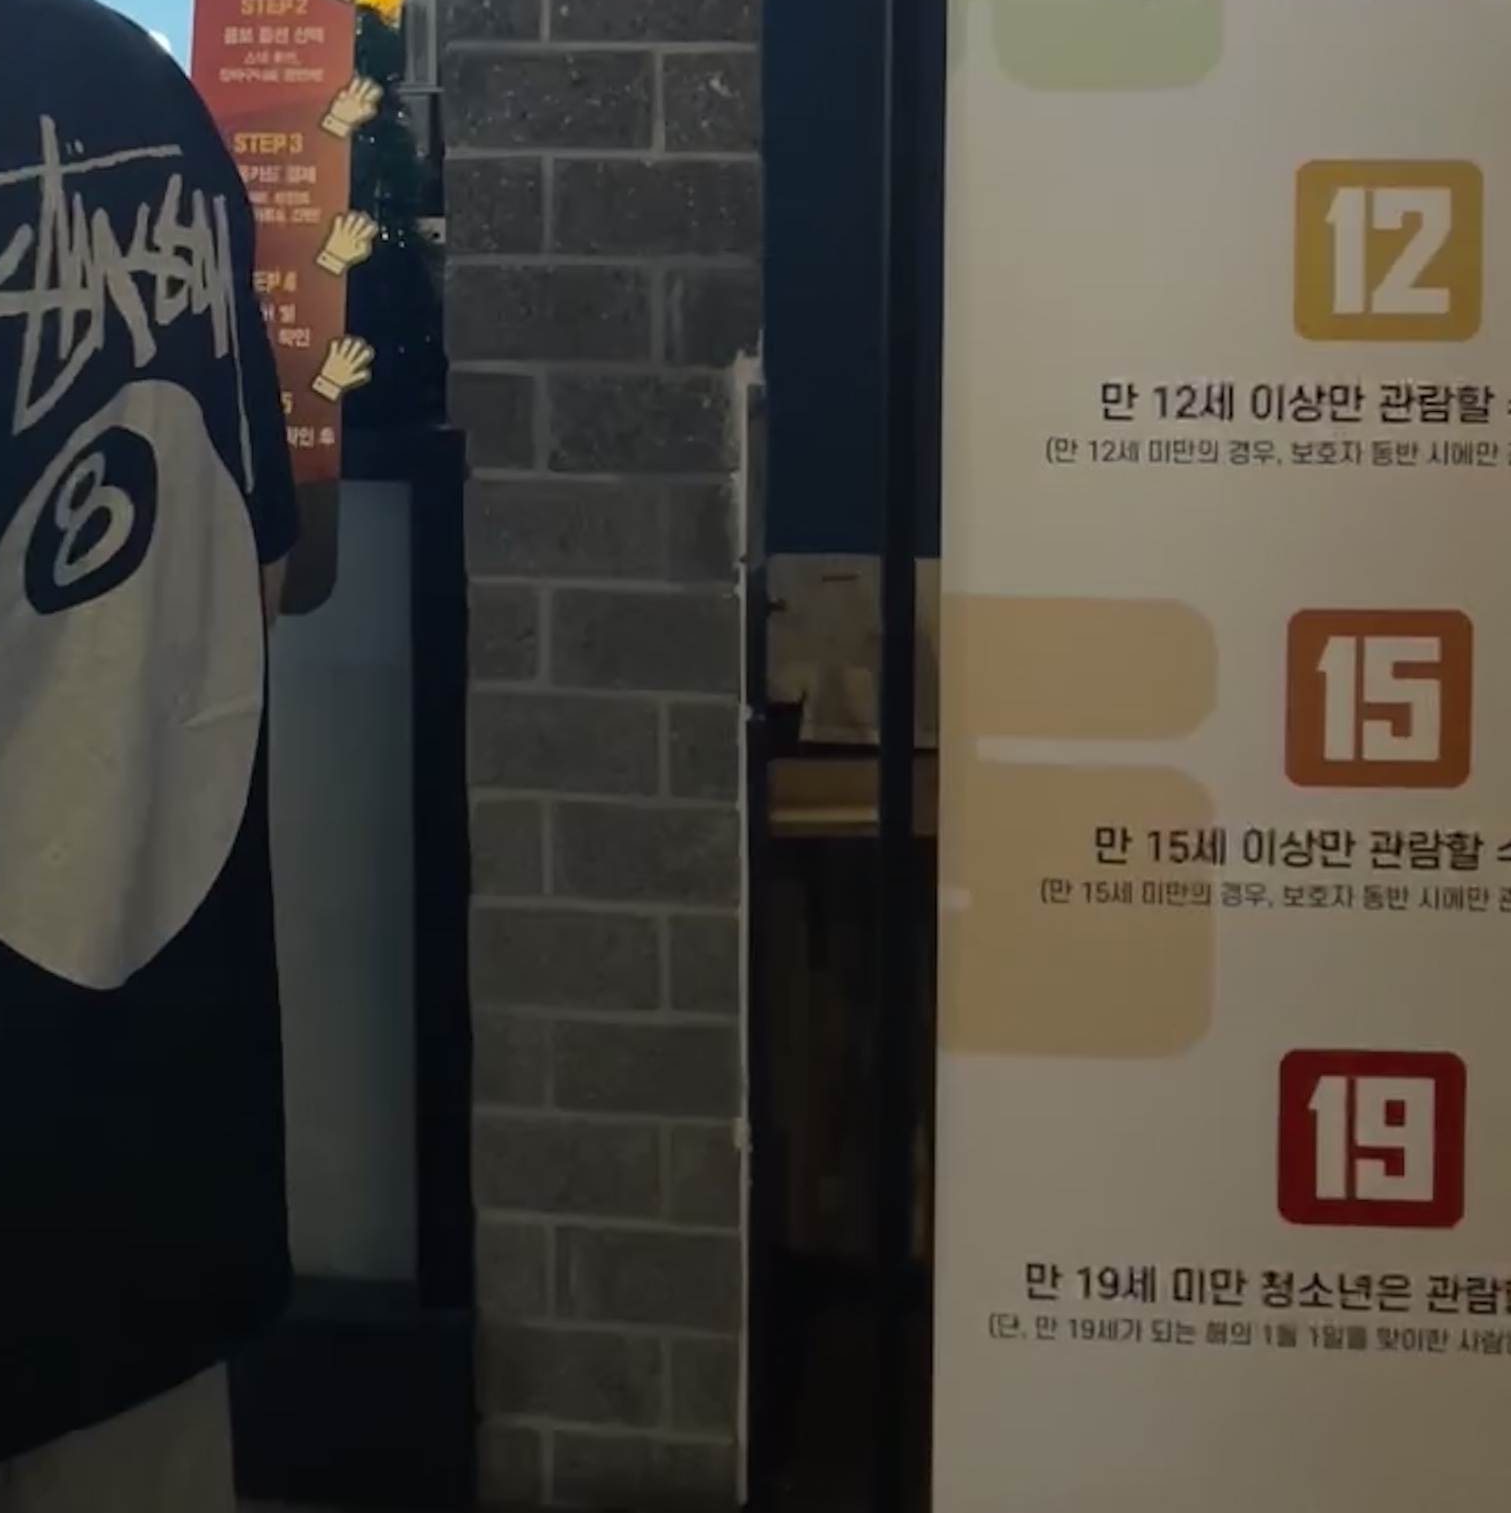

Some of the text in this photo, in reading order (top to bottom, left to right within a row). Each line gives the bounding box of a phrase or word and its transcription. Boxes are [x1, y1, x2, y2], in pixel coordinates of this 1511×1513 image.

[234, 133, 289, 154] STEP
[1324, 185, 1453, 316] 12
[1100, 382, 1497, 425] 만 12세 이상만 관람할
[1044, 436, 1079, 468] (만
[1088, 438, 1141, 466] 12세
[1147, 439, 1220, 467] 미만의
[1291, 439, 1363, 467] 보호자
[1370, 440, 1419, 468] 동반
[1426, 440, 1500, 468] 시에만
[53, 451, 136, 587] 8
[1316, 634, 1442, 763] 15
[1094, 826, 1485, 872] 만 15세 이상만 관람할
[1040, 876, 1074, 906] (만
[1082, 879, 1134, 906] 15세
[1141, 880, 1214, 908] 미만의
[1283, 884, 1357, 911] 보호자
[1362, 885, 1410, 912] 동반
[1417, 885, 1491, 914] 시에만
[1306, 1073, 1437, 1203] 19
[1025, 1262, 1065, 1302] 만
[1076, 1265, 1158, 1304] 19세
[1172, 1267, 1249, 1308] 미만
[1261, 1269, 1414, 1313] 청소년은
[1034, 1314, 1059, 1340] 만
[1068, 1317, 1144, 1344] 19세가
[1150, 1318, 1197, 1346] 되는
